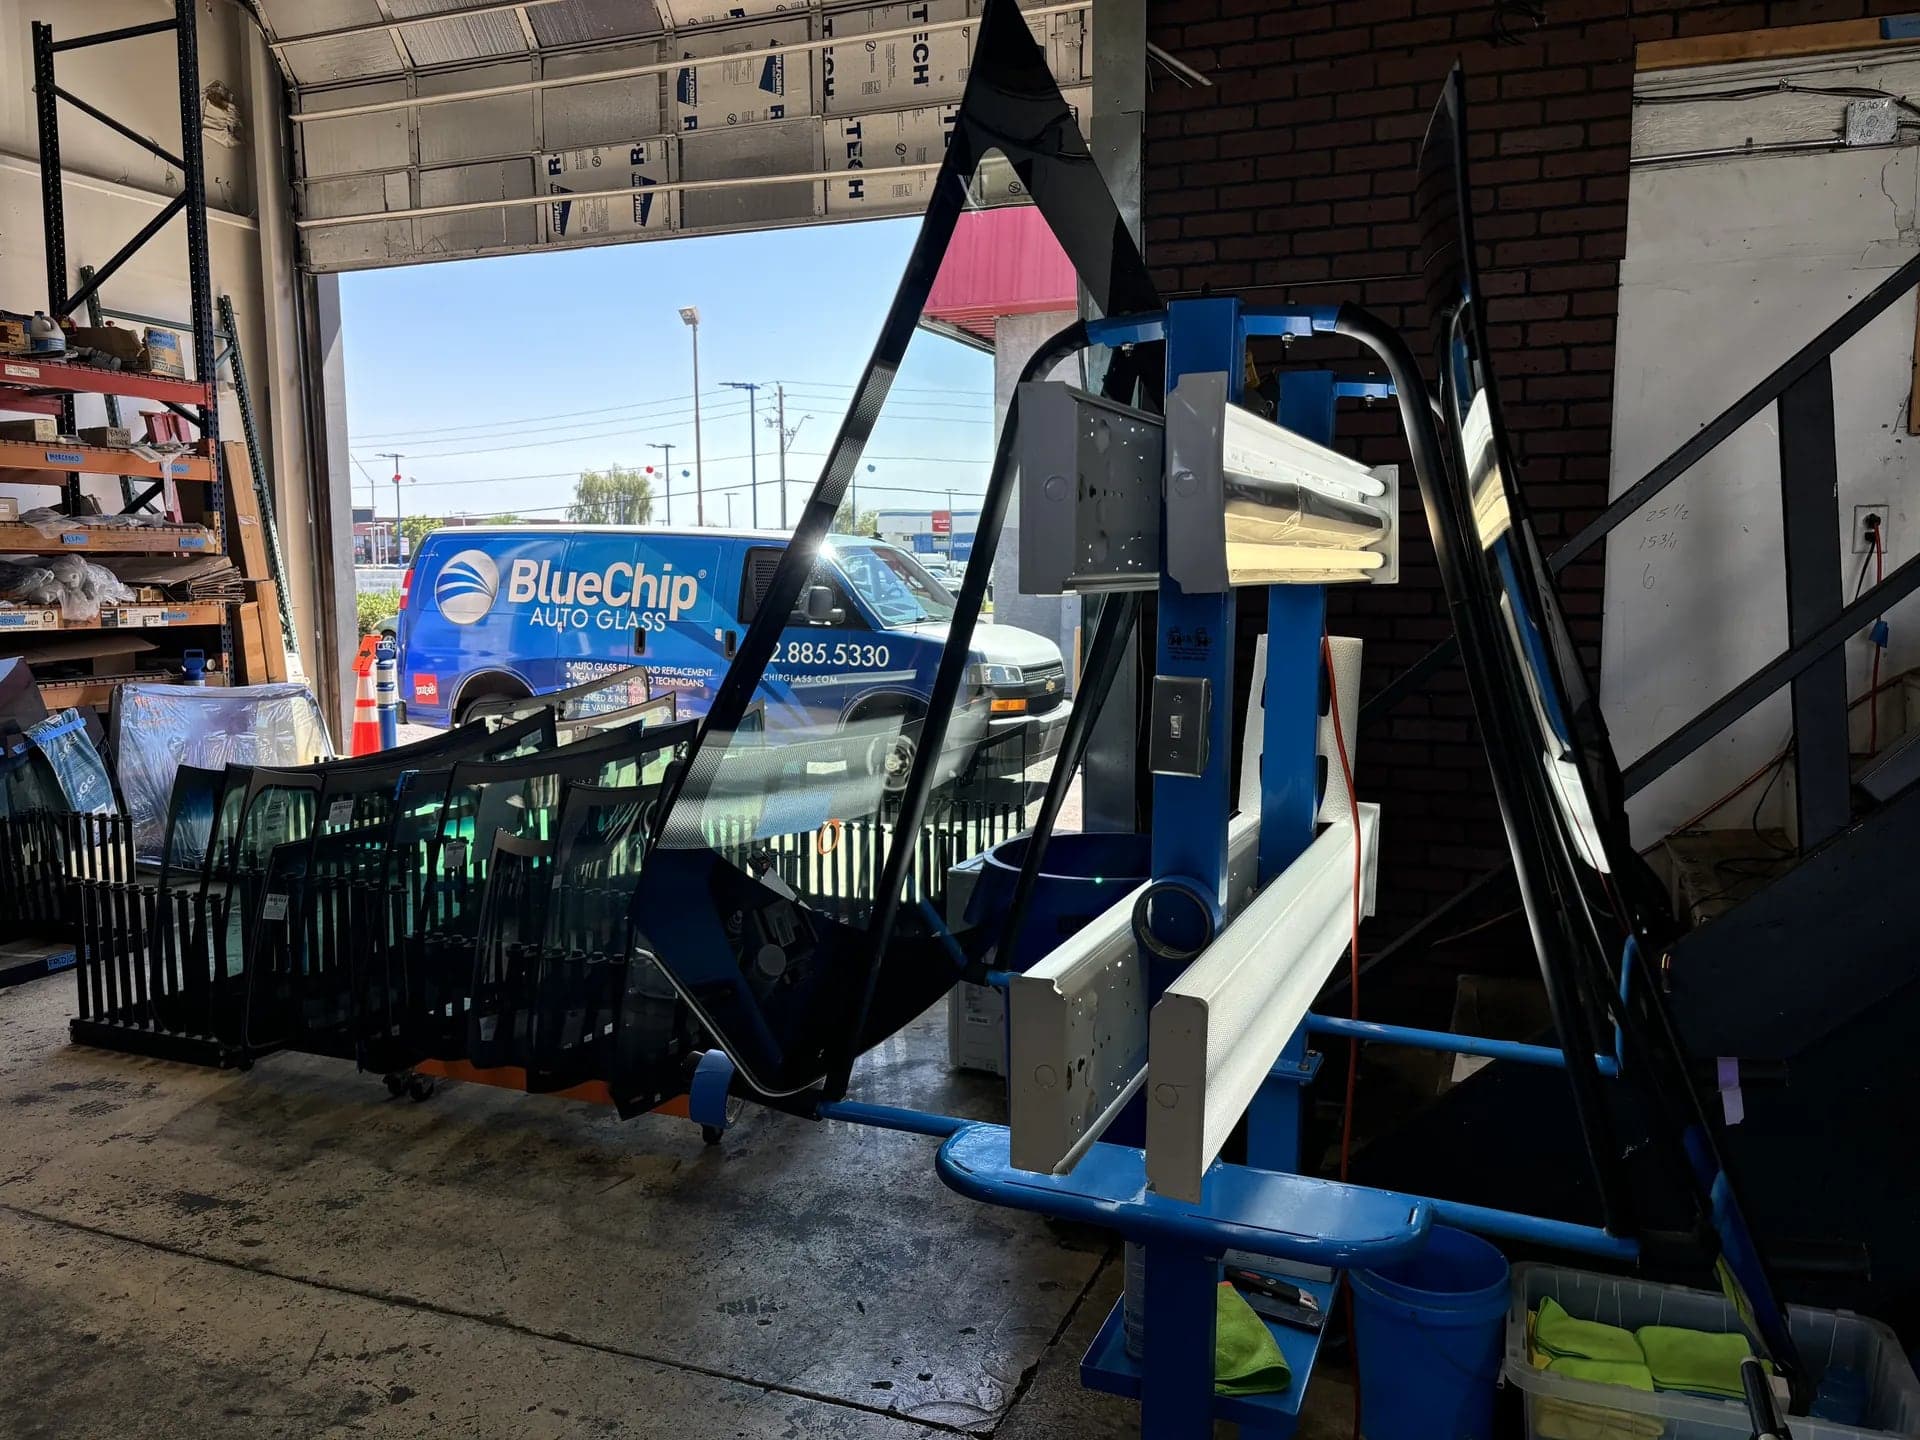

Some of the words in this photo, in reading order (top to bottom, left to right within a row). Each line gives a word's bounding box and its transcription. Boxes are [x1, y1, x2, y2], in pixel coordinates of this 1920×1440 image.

[508, 559, 698, 622] BlueChip
[529, 607, 589, 629] AUTO
[596, 609, 666, 632] GLASS
[573, 661, 593, 671] AUTO
[594, 662, 617, 672] GLASS
[661, 667, 713, 677] REPLACEMENT
[655, 676, 704, 688] TECHNICIANS
